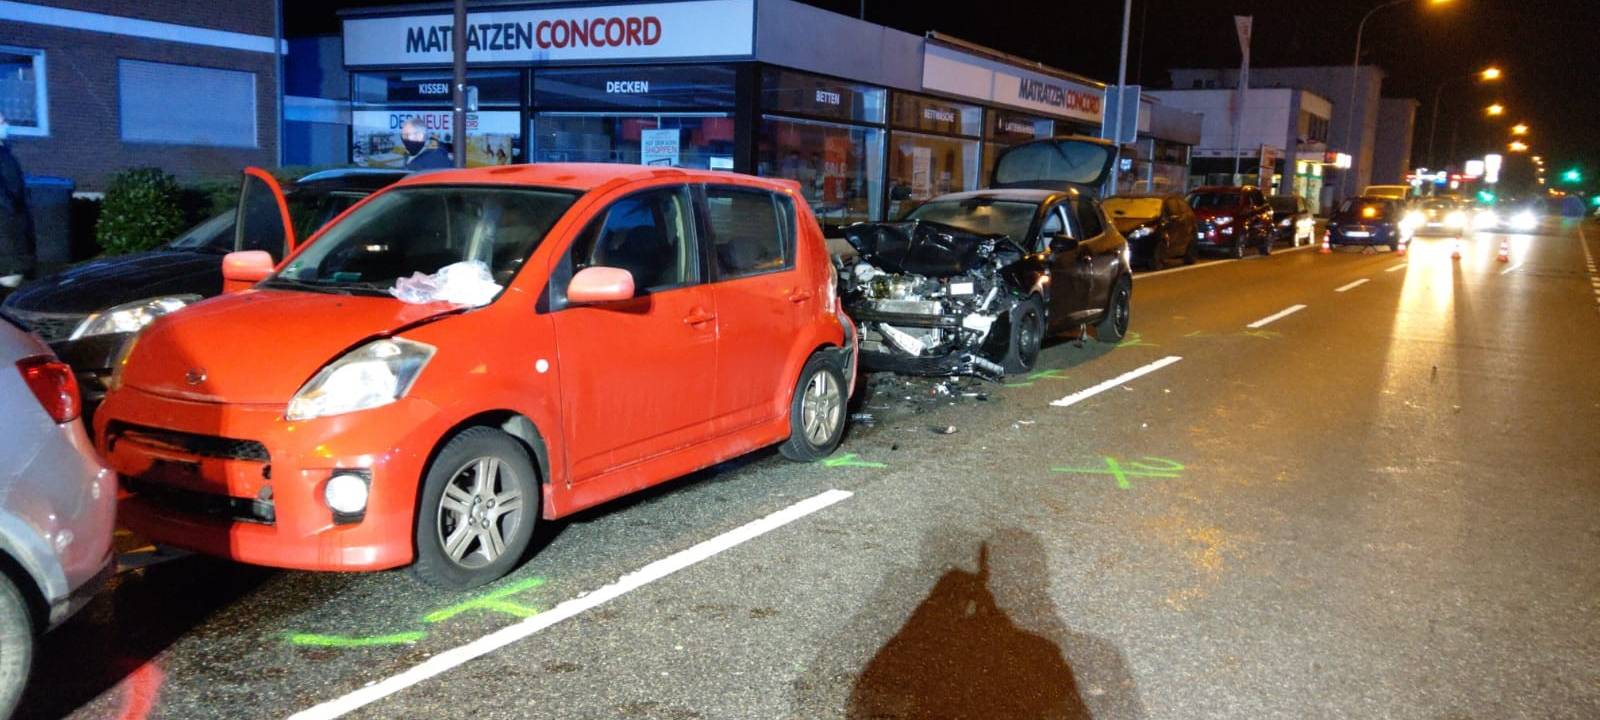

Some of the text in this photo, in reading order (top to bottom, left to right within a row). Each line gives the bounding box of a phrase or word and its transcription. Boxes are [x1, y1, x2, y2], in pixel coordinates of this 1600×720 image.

[406, 16, 661, 53] MATATZEN CONCORD
[419, 83, 449, 94] KISSEN
[606, 81, 649, 93] DECKEN
[815, 90, 840, 105] BETTEN
[1018, 78, 1100, 114] MATRATZEN CONCORD
